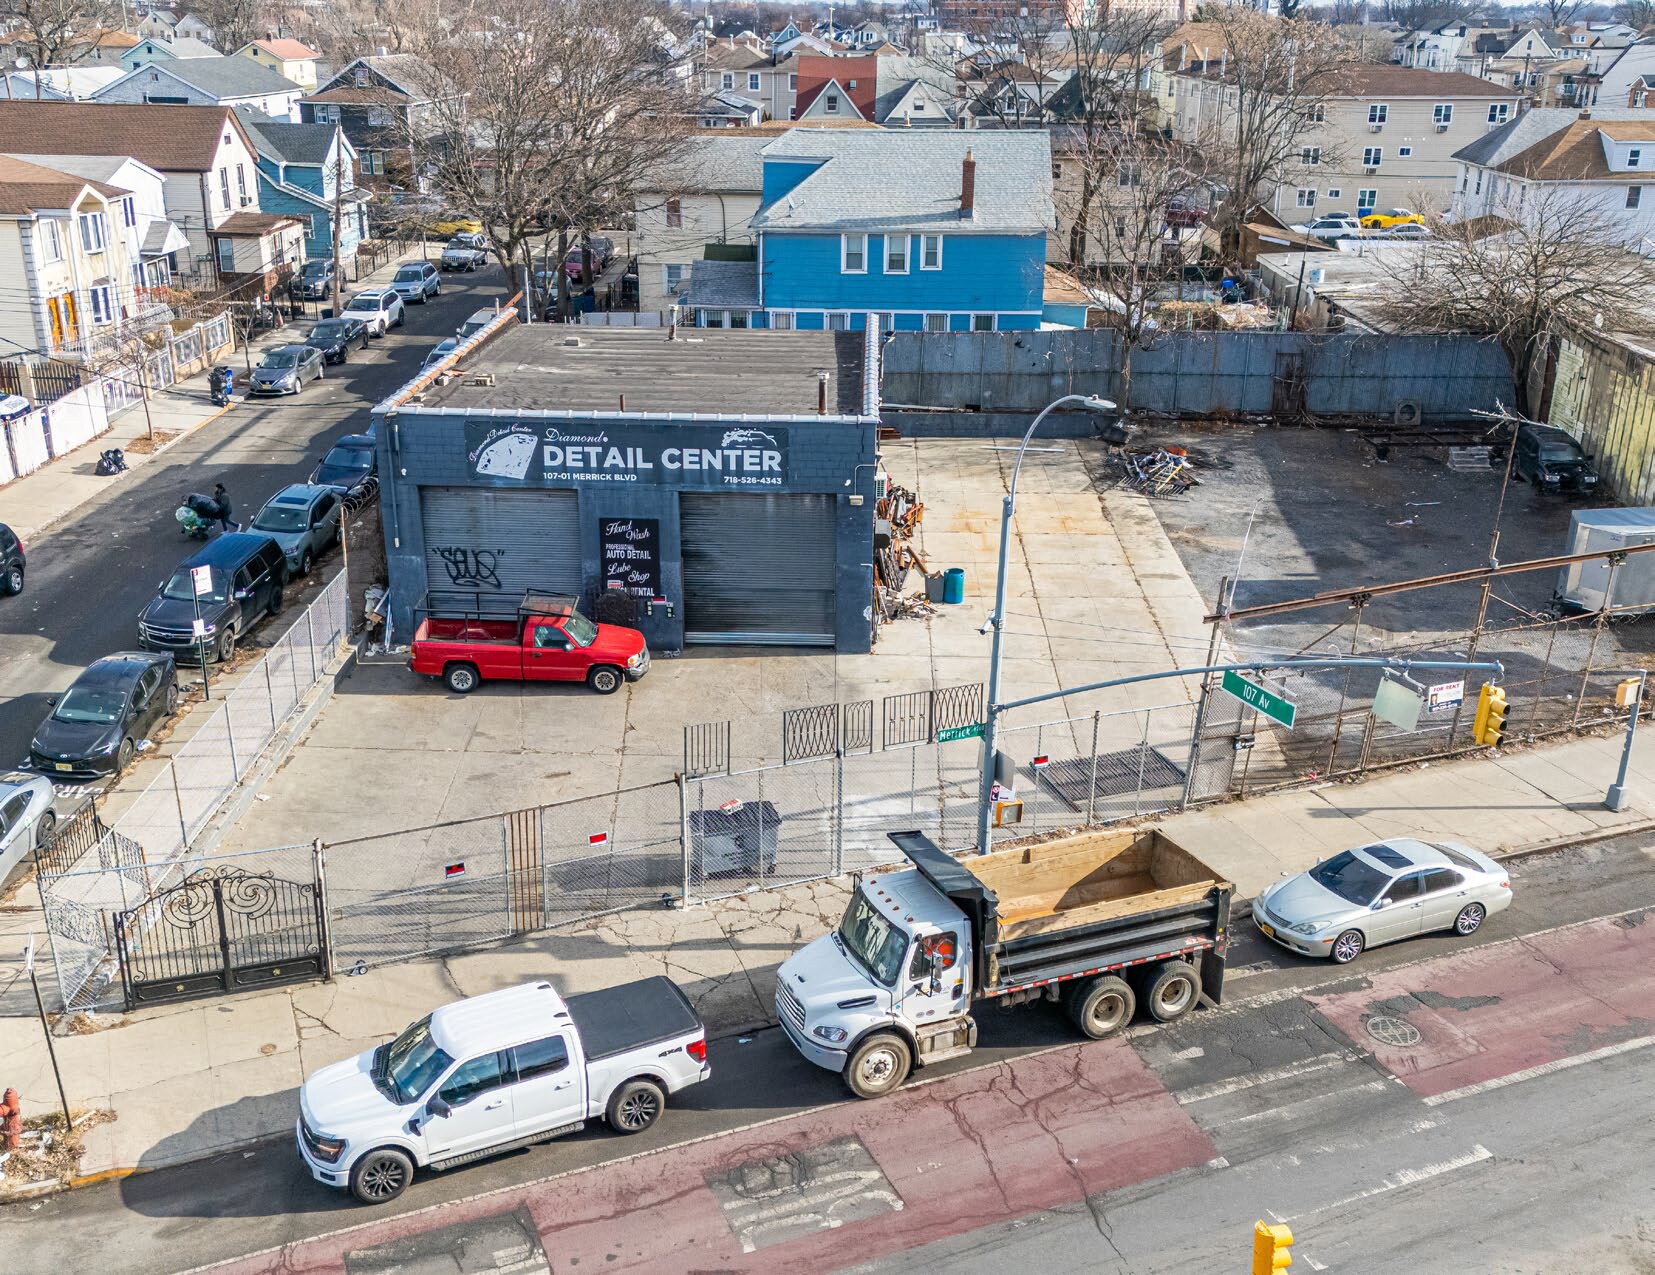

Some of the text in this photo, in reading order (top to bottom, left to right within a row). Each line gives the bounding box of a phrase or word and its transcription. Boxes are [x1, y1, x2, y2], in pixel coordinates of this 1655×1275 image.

[543, 445, 782, 471] DETAIL CENTER
[543, 472, 637, 482] 107-01 MERRICK BLVD
[724, 475, 782, 485] 718-526-4343
[606, 520, 632, 536] Hand
[626, 528, 650, 541] Wash
[606, 550, 651, 560] AUTO DETAIL
[607, 562, 631, 576] Lube
[627, 570, 650, 584] Shop
[1243, 684, 1271, 710] 107 Av
[939, 727, 971, 741] Merrick
